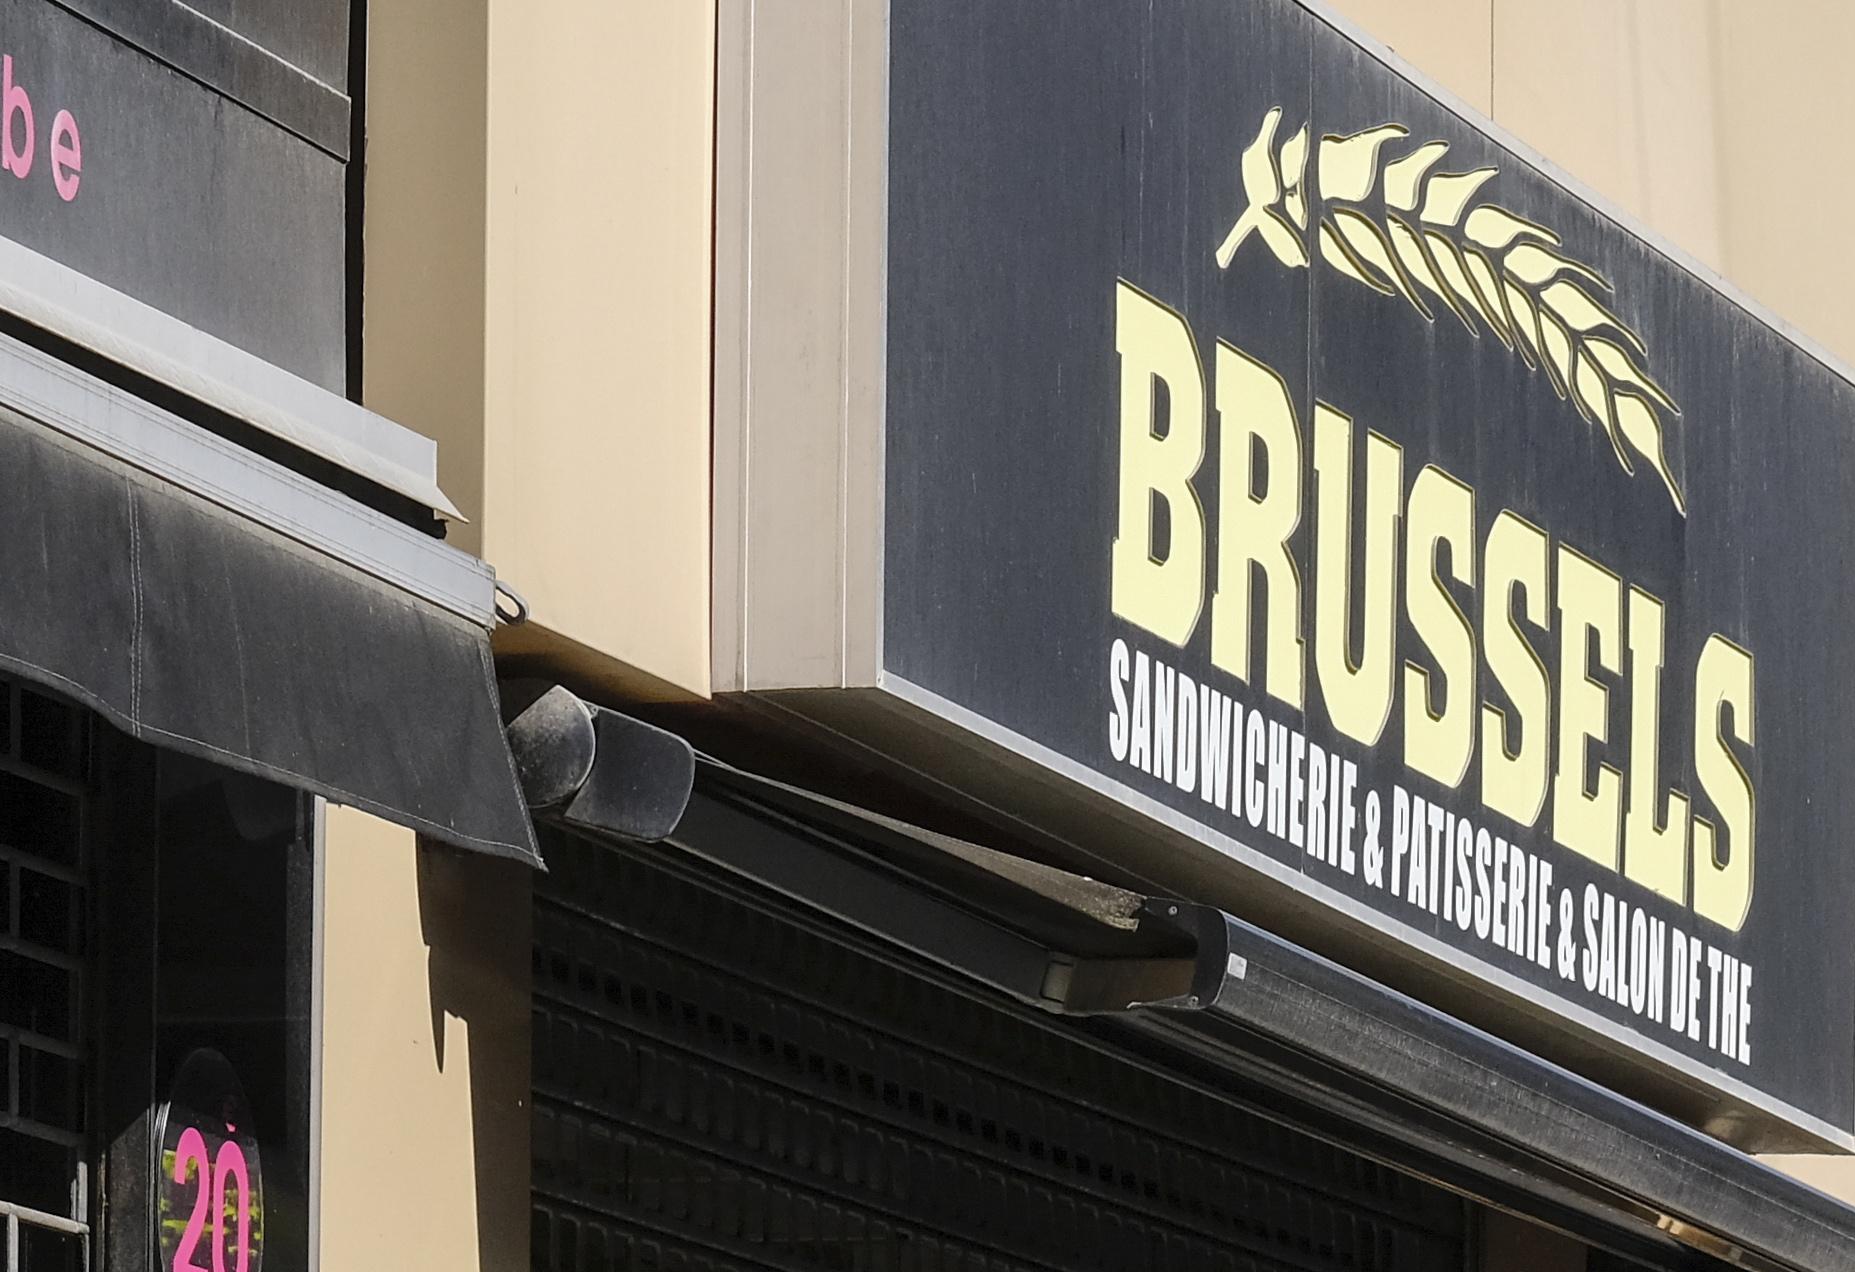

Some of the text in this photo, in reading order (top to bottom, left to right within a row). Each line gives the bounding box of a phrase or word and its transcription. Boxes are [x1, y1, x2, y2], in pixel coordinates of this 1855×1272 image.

[1109, 638, 1752, 1066] SANDWICHERIE & PATISSERIE & SALON DE THE
[1111, 277, 1755, 932] BRUSSELS
